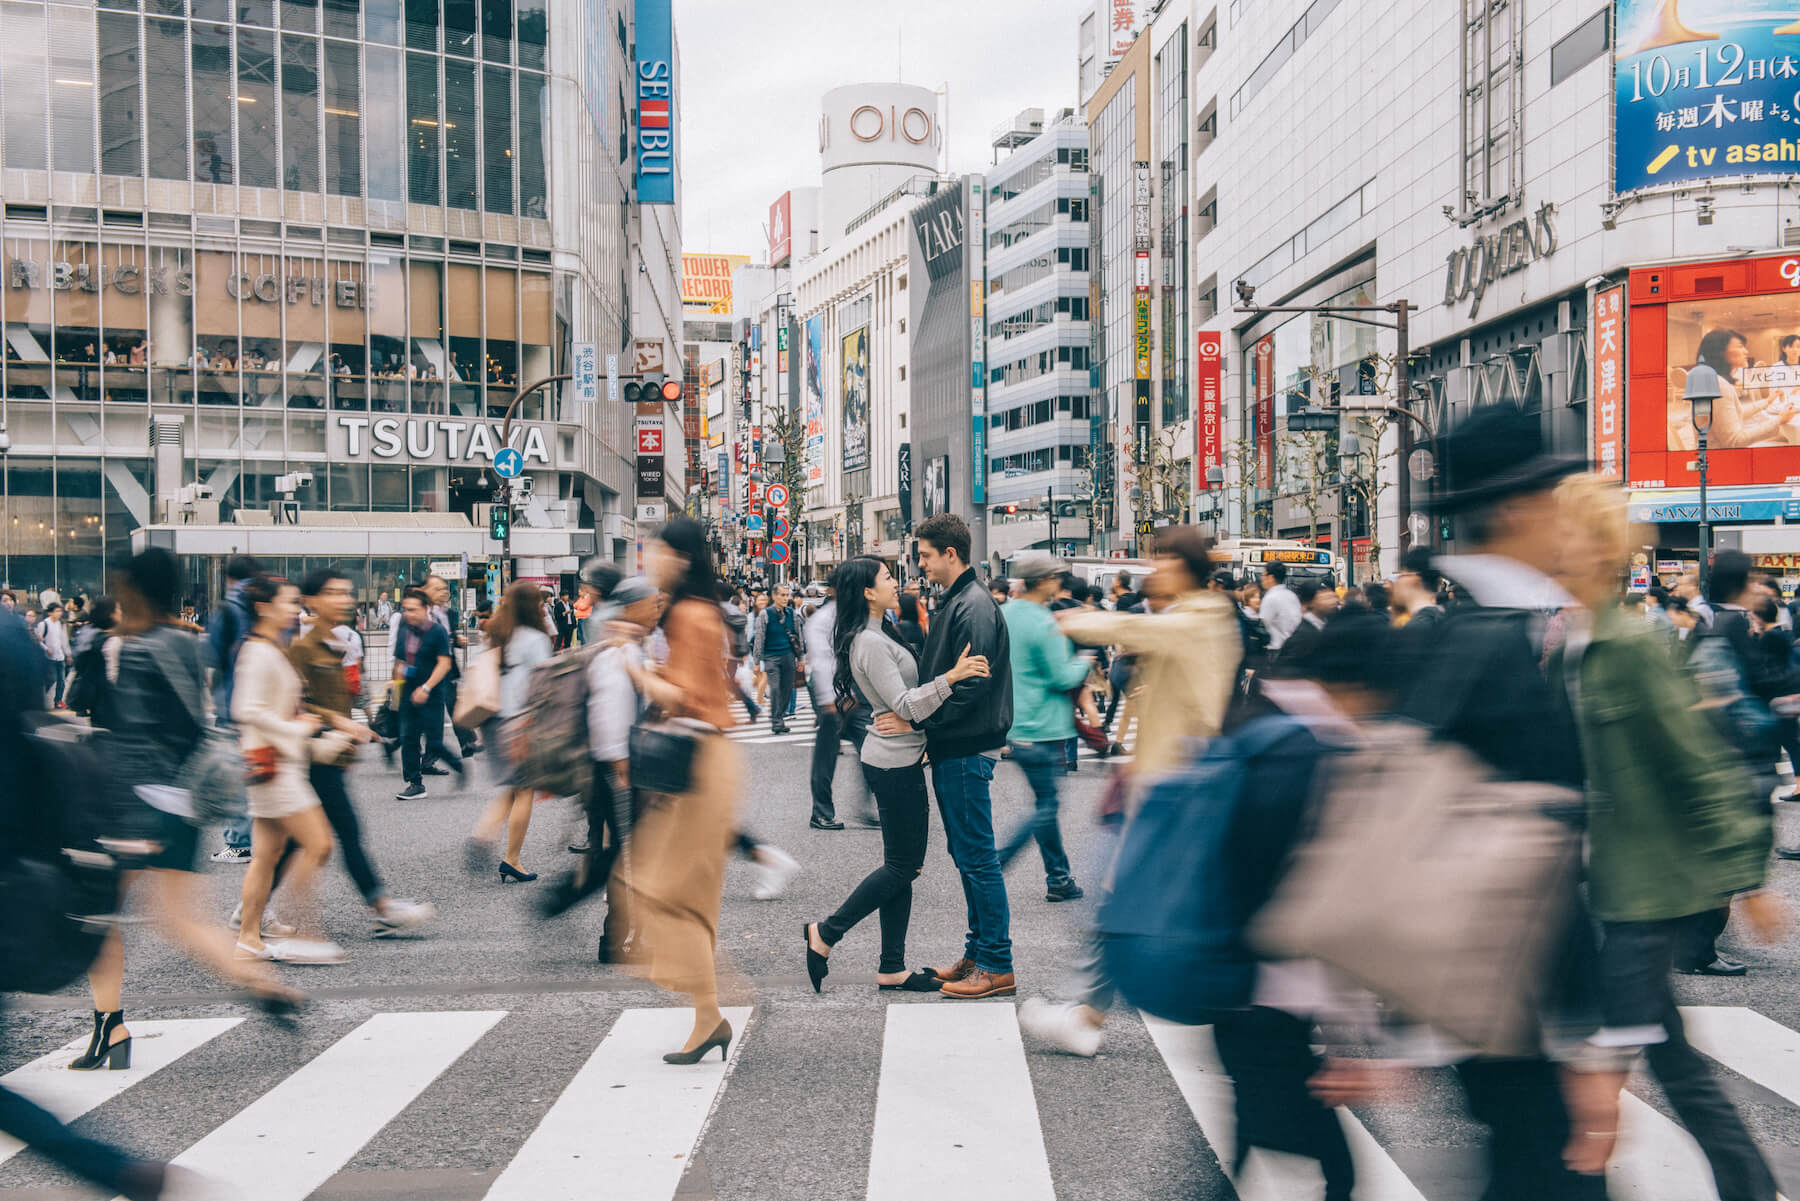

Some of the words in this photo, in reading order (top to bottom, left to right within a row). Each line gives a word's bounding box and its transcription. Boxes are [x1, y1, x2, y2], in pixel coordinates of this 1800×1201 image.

[639, 60, 670, 176] SEIBU
[1686, 145, 1717, 167] tv
[682, 257, 731, 277] TOWER
[226, 271, 377, 309] COFFEE
[583, 347, 594, 397] 渋谷駅前
[1600, 318, 1617, 477] 天津甘栗
[339, 418, 550, 463] TSUTAYA
[641, 431, 660, 450] 本
[1203, 377, 1217, 478] 三菱東京UFJ銀
[901, 451, 909, 491] ZARA
[1654, 504, 1741, 520] SANZNRI
[1753, 554, 1787, 567] TAX
